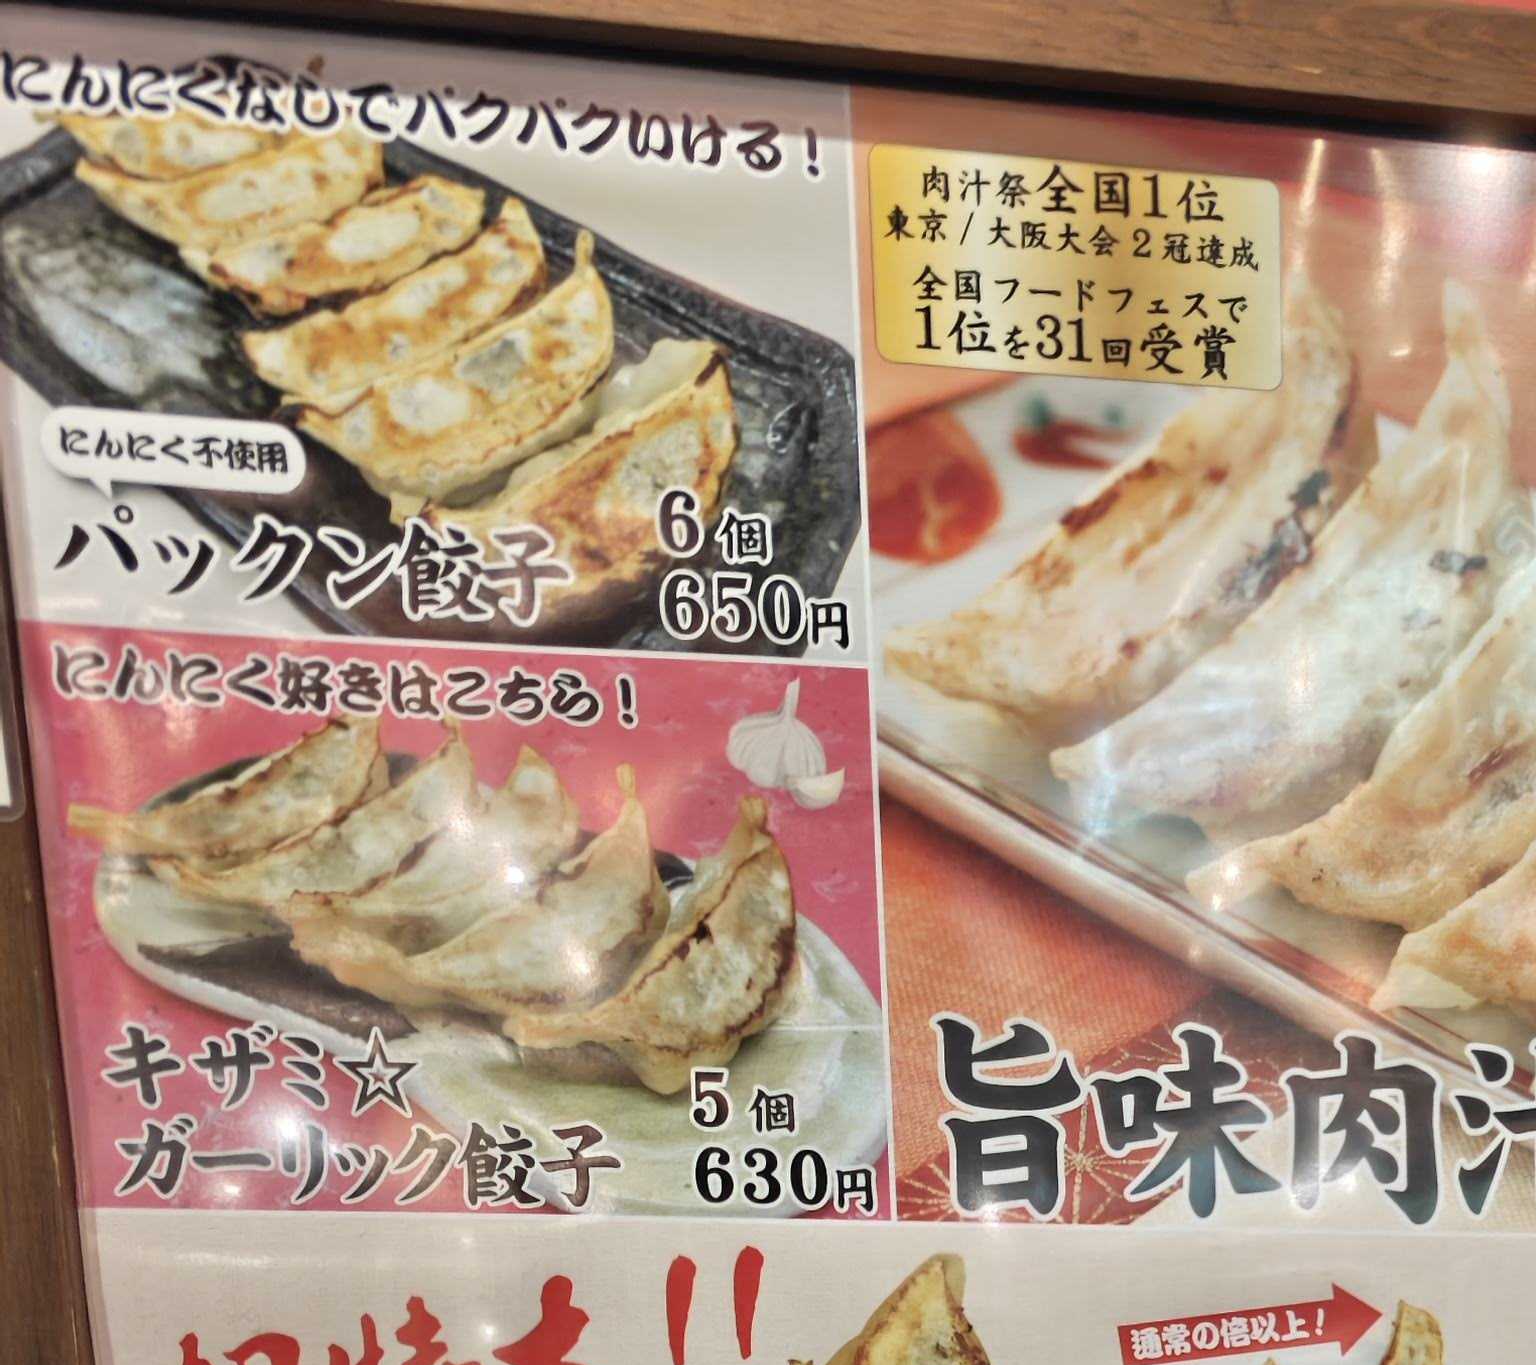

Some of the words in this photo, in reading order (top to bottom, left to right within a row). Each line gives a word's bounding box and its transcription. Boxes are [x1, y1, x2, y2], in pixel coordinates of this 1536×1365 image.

[2, 51, 824, 177] にんにくなしでパクパクいける！
[921, 164, 1225, 223] 肉汁祭全国1位
[884, 205, 1260, 272] 東京／大阪大会2冠達成
[913, 265, 1248, 324] 全国フードフェスで
[913, 306, 1236, 381] 1位を31回受賞
[60, 428, 290, 475] にんにく不使用
[53, 503, 571, 626] パックン餃子
[658, 492, 772, 567] 6個
[661, 575, 850, 648] 650円
[54, 646, 639, 728] にんにく好きはこちら！
[692, 1070, 796, 1133] 5個
[116, 1117, 623, 1210] ガーリック餃子
[694, 1149, 877, 1213] 630円
[1131, 1308, 1324, 1360] 通常の倍以上！
